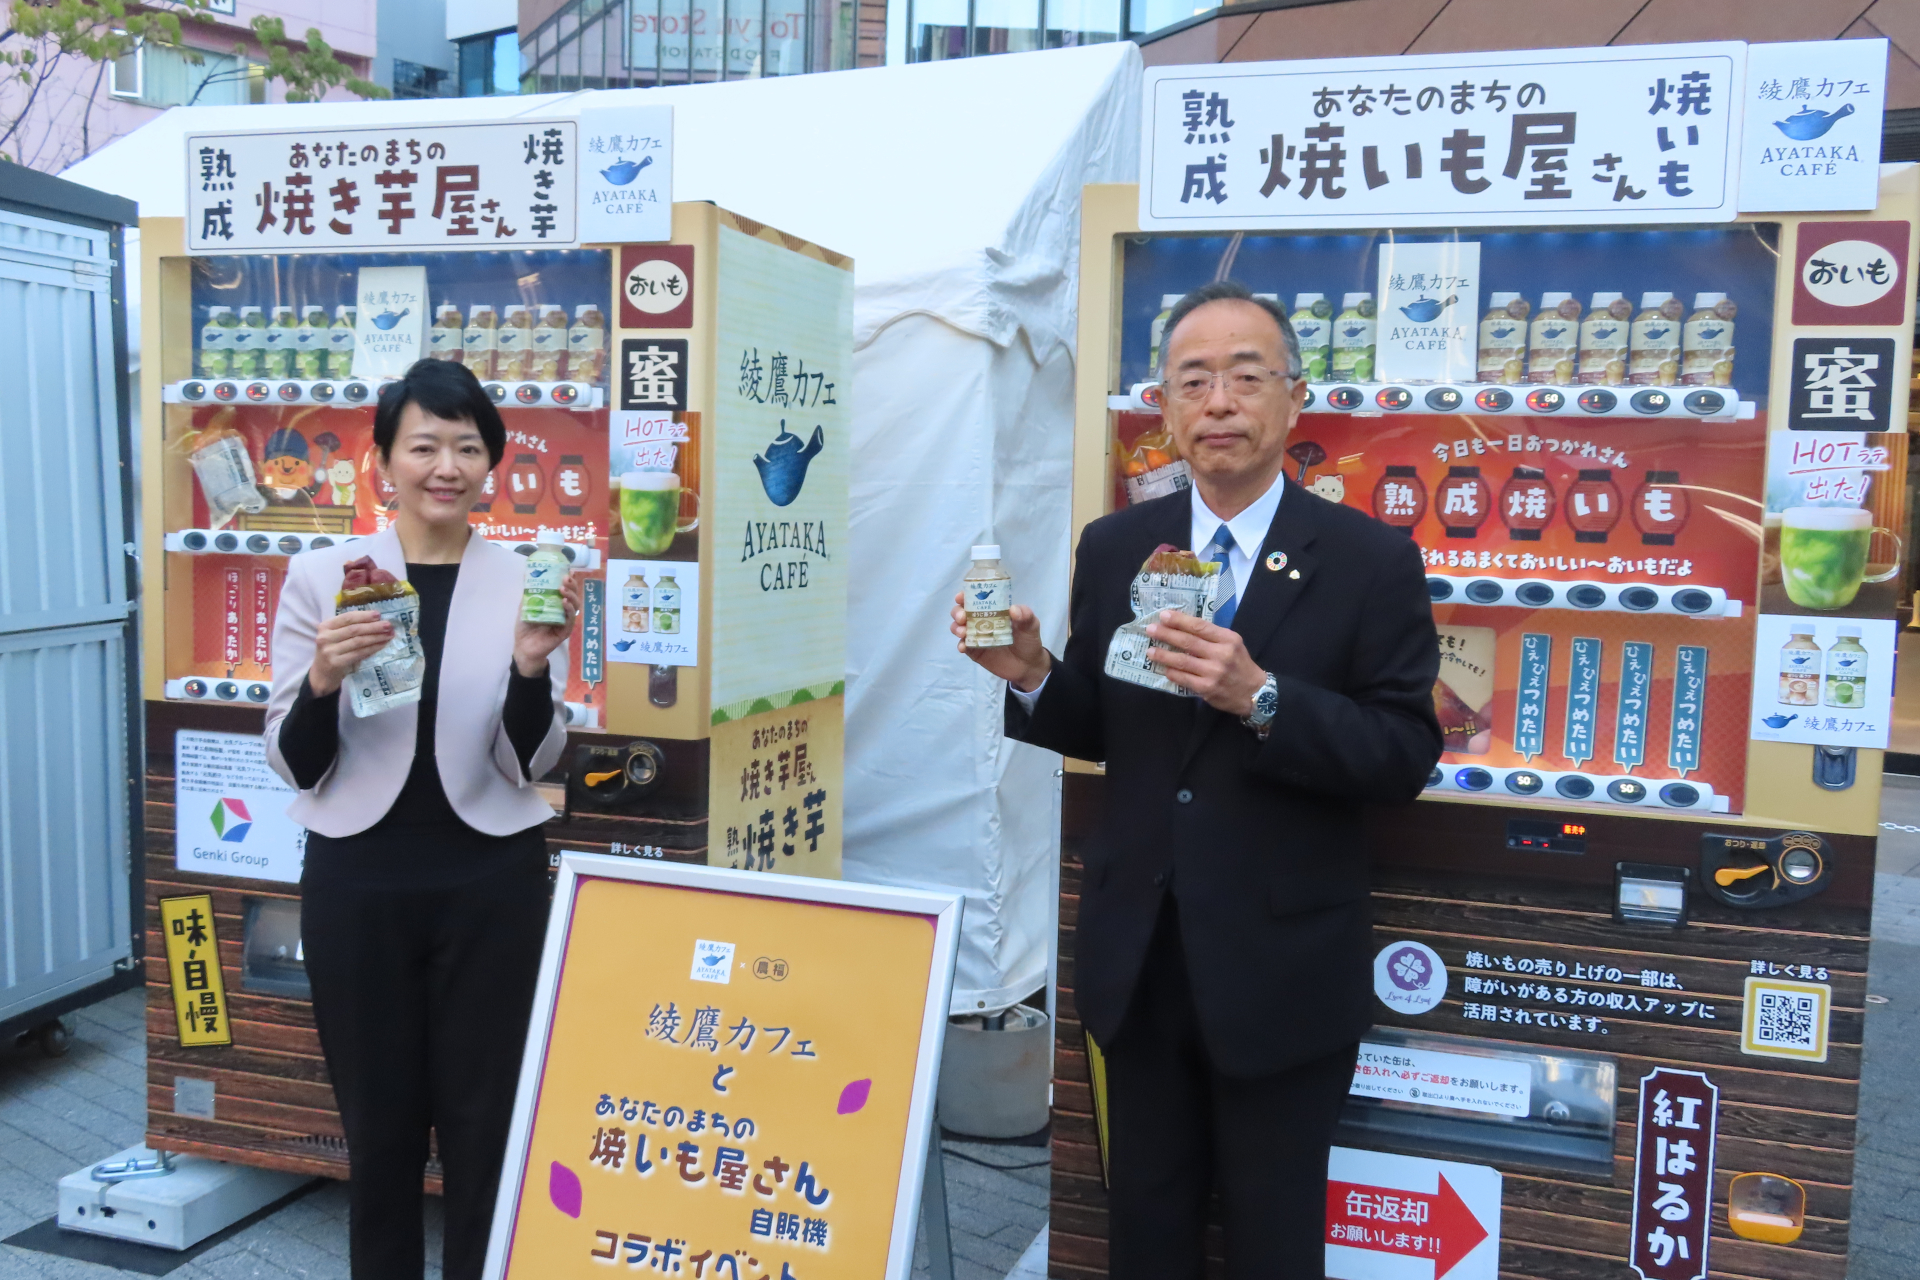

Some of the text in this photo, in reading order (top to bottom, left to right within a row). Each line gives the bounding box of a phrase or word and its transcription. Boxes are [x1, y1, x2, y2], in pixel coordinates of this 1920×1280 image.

[1311, 82, 1547, 119] あなたのまちの
[1757, 76, 1871, 103] 綾鷹カフェ
[588, 133, 663, 155] 綾鷹カフェ
[1179, 88, 1236, 206] 熟成
[1648, 70, 1712, 198] 焼いも
[289, 140, 447, 169] あなたのまちの
[1258, 111, 1647, 203] 焼いも屋さん
[1759, 144, 1860, 166] AYATAKA
[1780, 158, 1837, 177] CAFÉ
[199, 145, 237, 241] 熟成
[255, 164, 516, 238] 焼き芋屋さん
[522, 128, 565, 239] 焼き芋
[591, 188, 659, 206] AYATAKA
[605, 198, 644, 215] CAFÉ
[629, 274, 683, 297] おいも
[1387, 273, 1471, 292] 綾鷹カフェ
[1809, 258, 1890, 286] おいも
[362, 290, 418, 306] 綾鷹カフェ
[363, 333, 412, 345] AYATAKA
[1389, 326, 1463, 342] AYATAKA
[1404, 336, 1448, 351] CAFÉ
[628, 345, 679, 405] 蜜
[738, 347, 837, 408] 綾鷹カフェ
[1801, 346, 1880, 421] 蜜
[1432, 434, 1628, 470] 今日も一日おつかれさん
[1806, 476, 1869, 502] 出た!
[741, 520, 828, 563] AYATAKA
[760, 553, 810, 592] CAFÉ
[226, 571, 241, 661] ほっこりあったか
[255, 571, 269, 661] ほっこりあったか
[584, 581, 602, 677] ひえひえつめたい
[640, 641, 690, 655] 綾鷹カフェ
[1519, 636, 1545, 748] ひえひえつめたい
[1570, 641, 1596, 753] ひえひえつめたい
[1620, 645, 1647, 759] ひえひえつめたい
[1675, 649, 1701, 763] ひえひえつめたい
[752, 719, 809, 750] あなたのまちの
[1803, 716, 1877, 733] 綾鷹カフェ
[740, 743, 817, 802] 焼き芋屋さん
[742, 788, 827, 872] 焼き芋
[193, 847, 270, 868] Genki Group
[610, 842, 664, 858] 詳しく見る
[697, 942, 732, 955] 綾鷹カフェ
[172, 908, 220, 1034] 味自慢
[696, 965, 726, 979] AYATAKA
[756, 959, 786, 978] 農福
[1464, 950, 1684, 991] 焼いもの売り上げの一部は、
[1749, 959, 1830, 982] 詳しく見る
[1463, 976, 1717, 1020] 障がいがある方の収入アップに
[644, 1001, 817, 1058] 綾鷹カフェ
[1462, 1002, 1610, 1035] 活用されています。
[711, 1063, 735, 1093] と
[595, 1093, 755, 1140] あなたのまちの
[588, 1126, 830, 1206] 焼いも屋さん
[1647, 1088, 1703, 1267] 紅はるか
[1346, 1189, 1429, 1226] 缶返却
[749, 1207, 829, 1248] 自販機
[1330, 1222, 1442, 1254] お願いします!!
